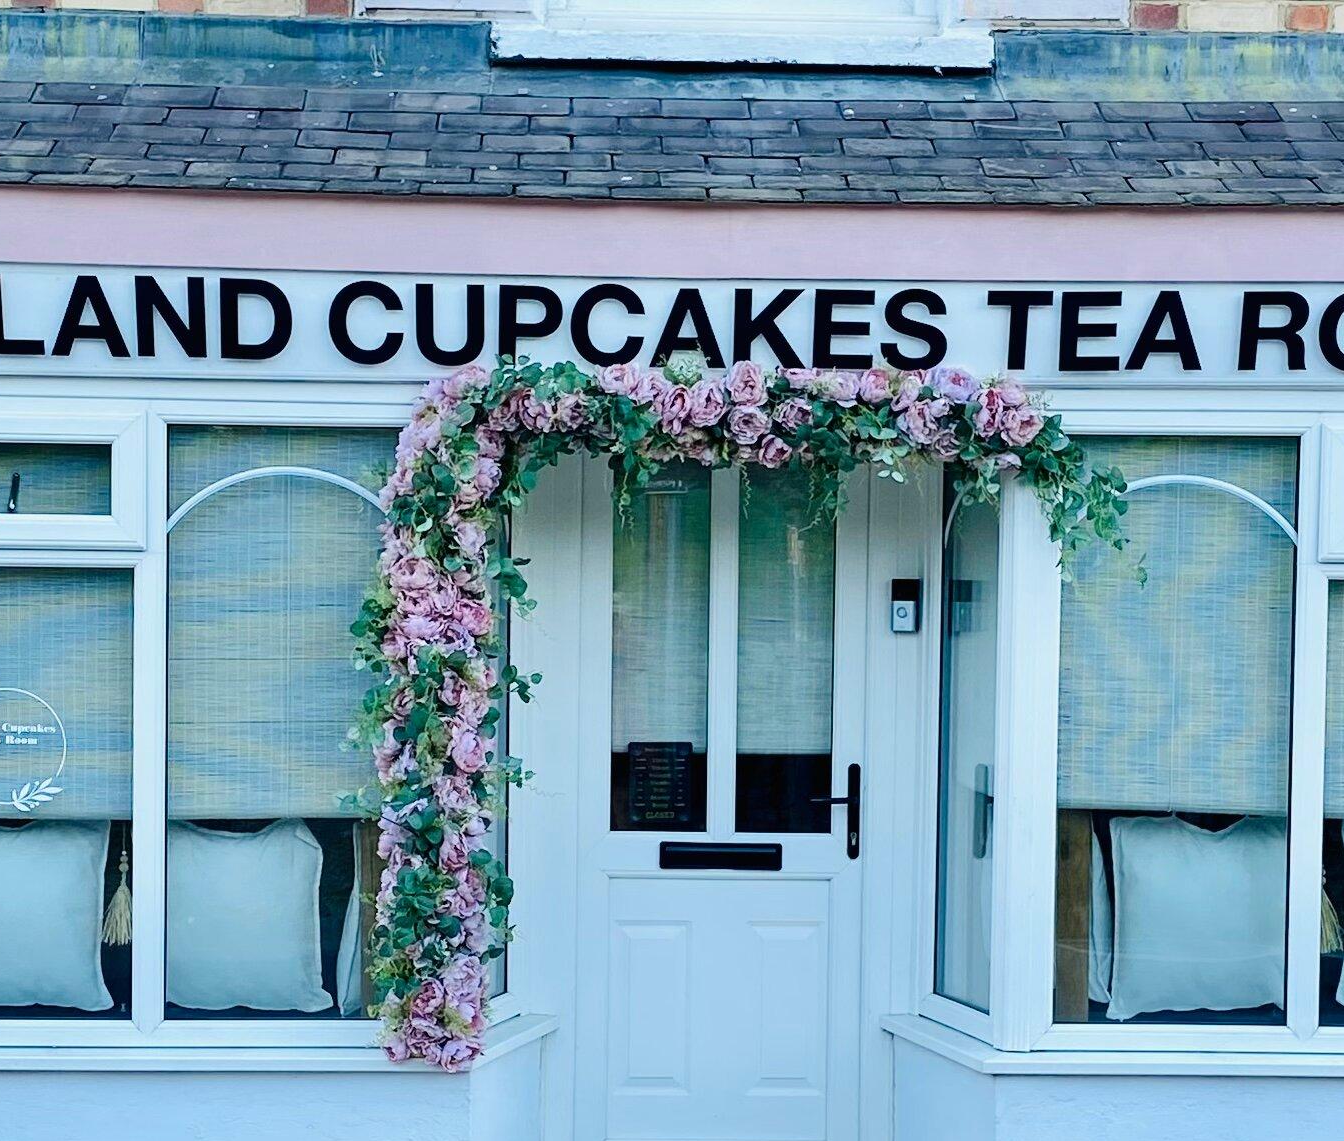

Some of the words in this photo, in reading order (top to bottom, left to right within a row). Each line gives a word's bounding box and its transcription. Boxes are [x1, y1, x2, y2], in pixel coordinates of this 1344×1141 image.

[328, 280, 949, 372] CUPCAKES
[987, 290, 1203, 372] TEA
[1, 722, 56, 735] Cupcakes
[5, 735, 38, 745] Room
